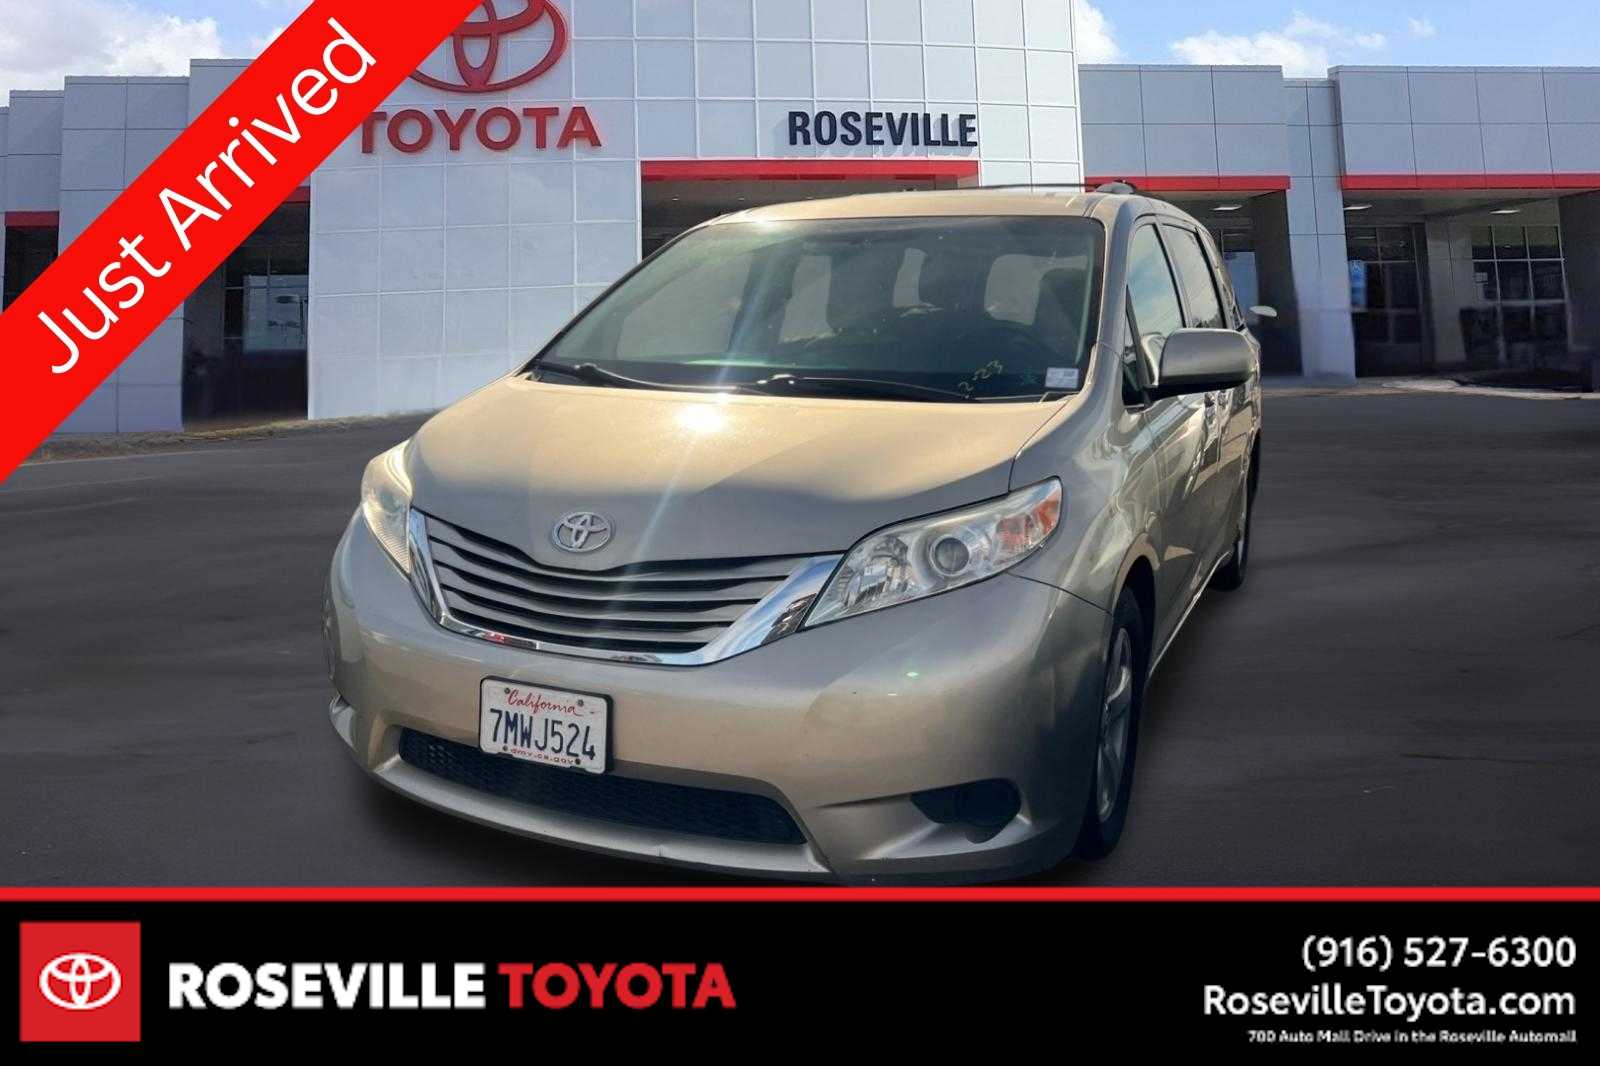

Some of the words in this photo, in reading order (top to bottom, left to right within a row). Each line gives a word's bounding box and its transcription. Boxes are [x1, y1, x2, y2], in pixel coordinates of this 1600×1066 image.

[359, 106, 602, 154] TOYOTA
[788, 111, 978, 148] ROSEVILLE
[508, 688, 583, 716] California
[489, 707, 596, 760] 7MWJ524
